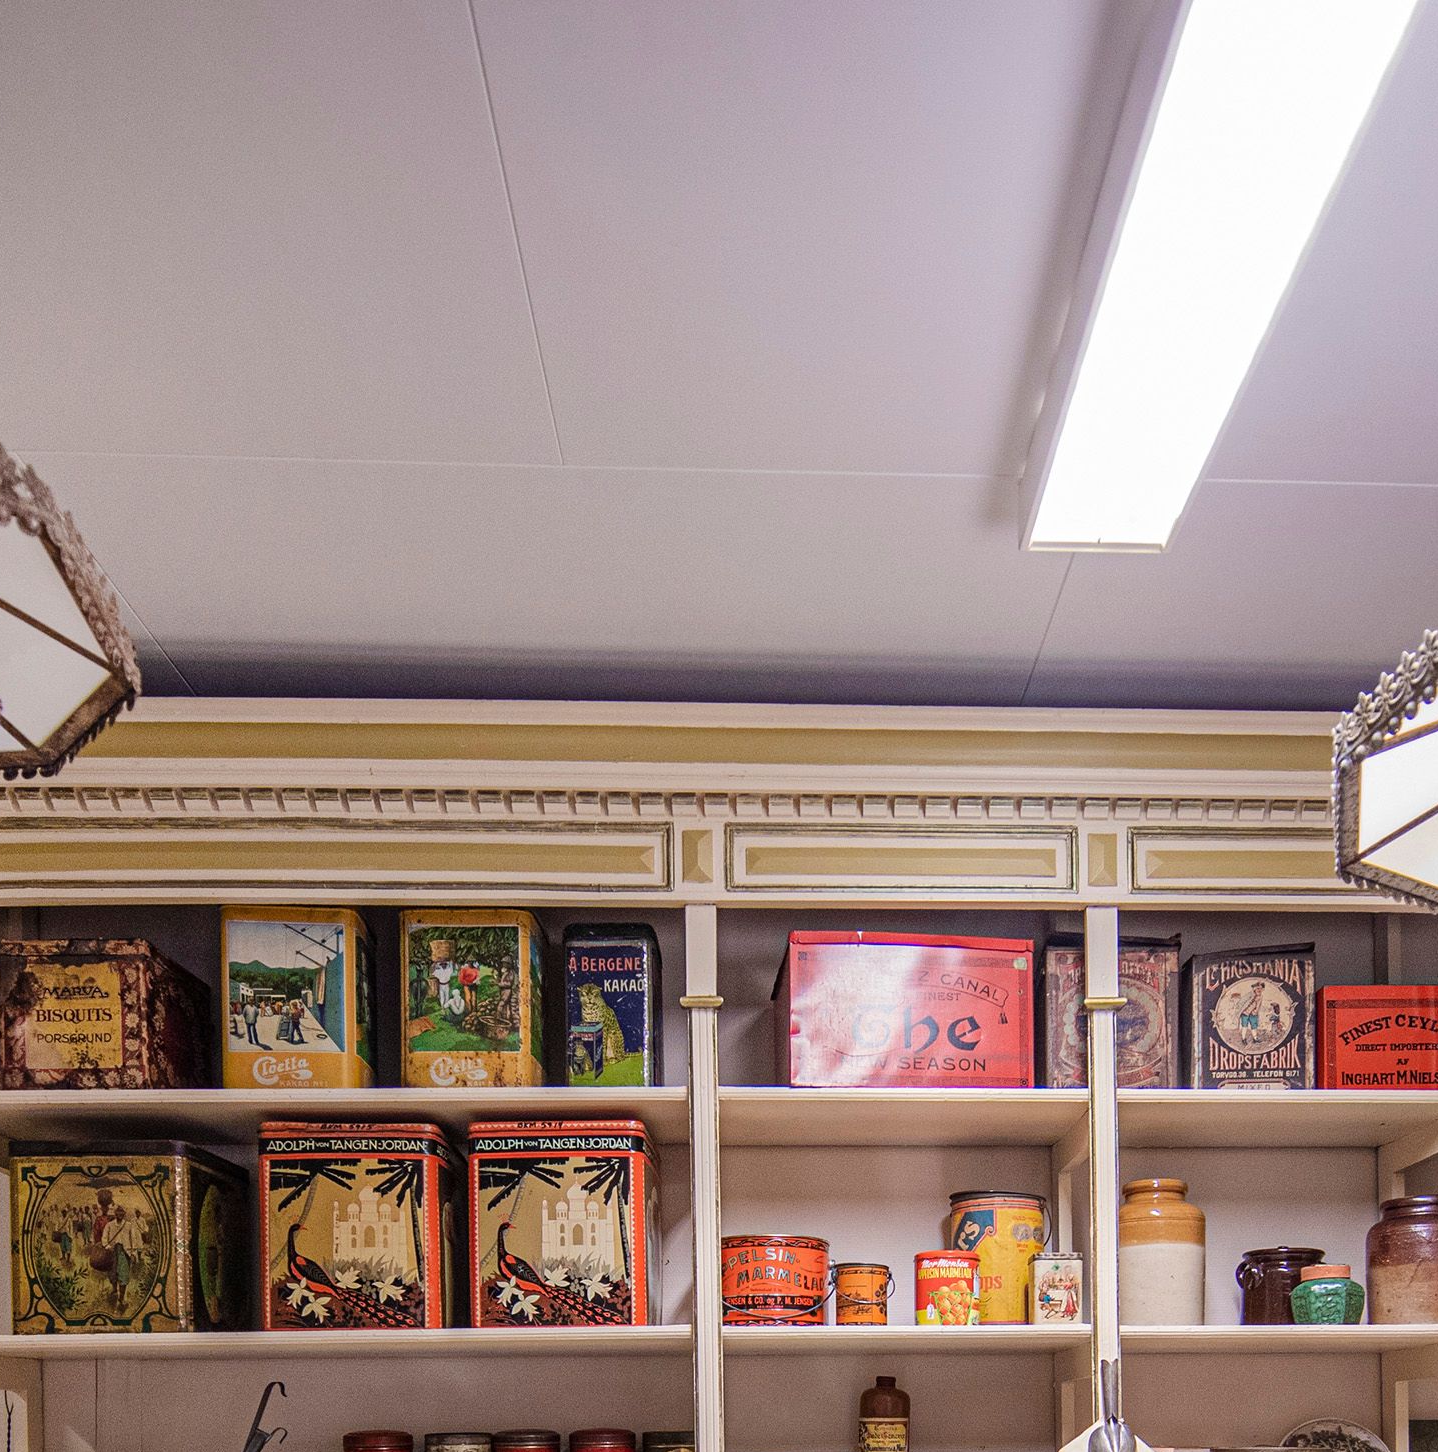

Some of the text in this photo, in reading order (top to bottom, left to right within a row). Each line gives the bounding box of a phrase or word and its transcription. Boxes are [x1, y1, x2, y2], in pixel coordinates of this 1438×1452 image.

[581, 956, 642, 972] BERGENE
[604, 978, 644, 992] KAKAO
[940, 973, 1001, 1001] CANAL
[35, 1008, 113, 1024] BISQUITS
[1339, 1015, 1392, 1046] FINEST
[36, 1033, 112, 1044] PORSGRUND
[1355, 1044, 1387, 1052] DIRECT
[898, 1057, 986, 1072] SEASON
[1253, 1070, 1283, 1078] TELEFON
[266, 1138, 315, 1152] ADOLPH
[475, 1137, 524, 1151] ADOLPH
